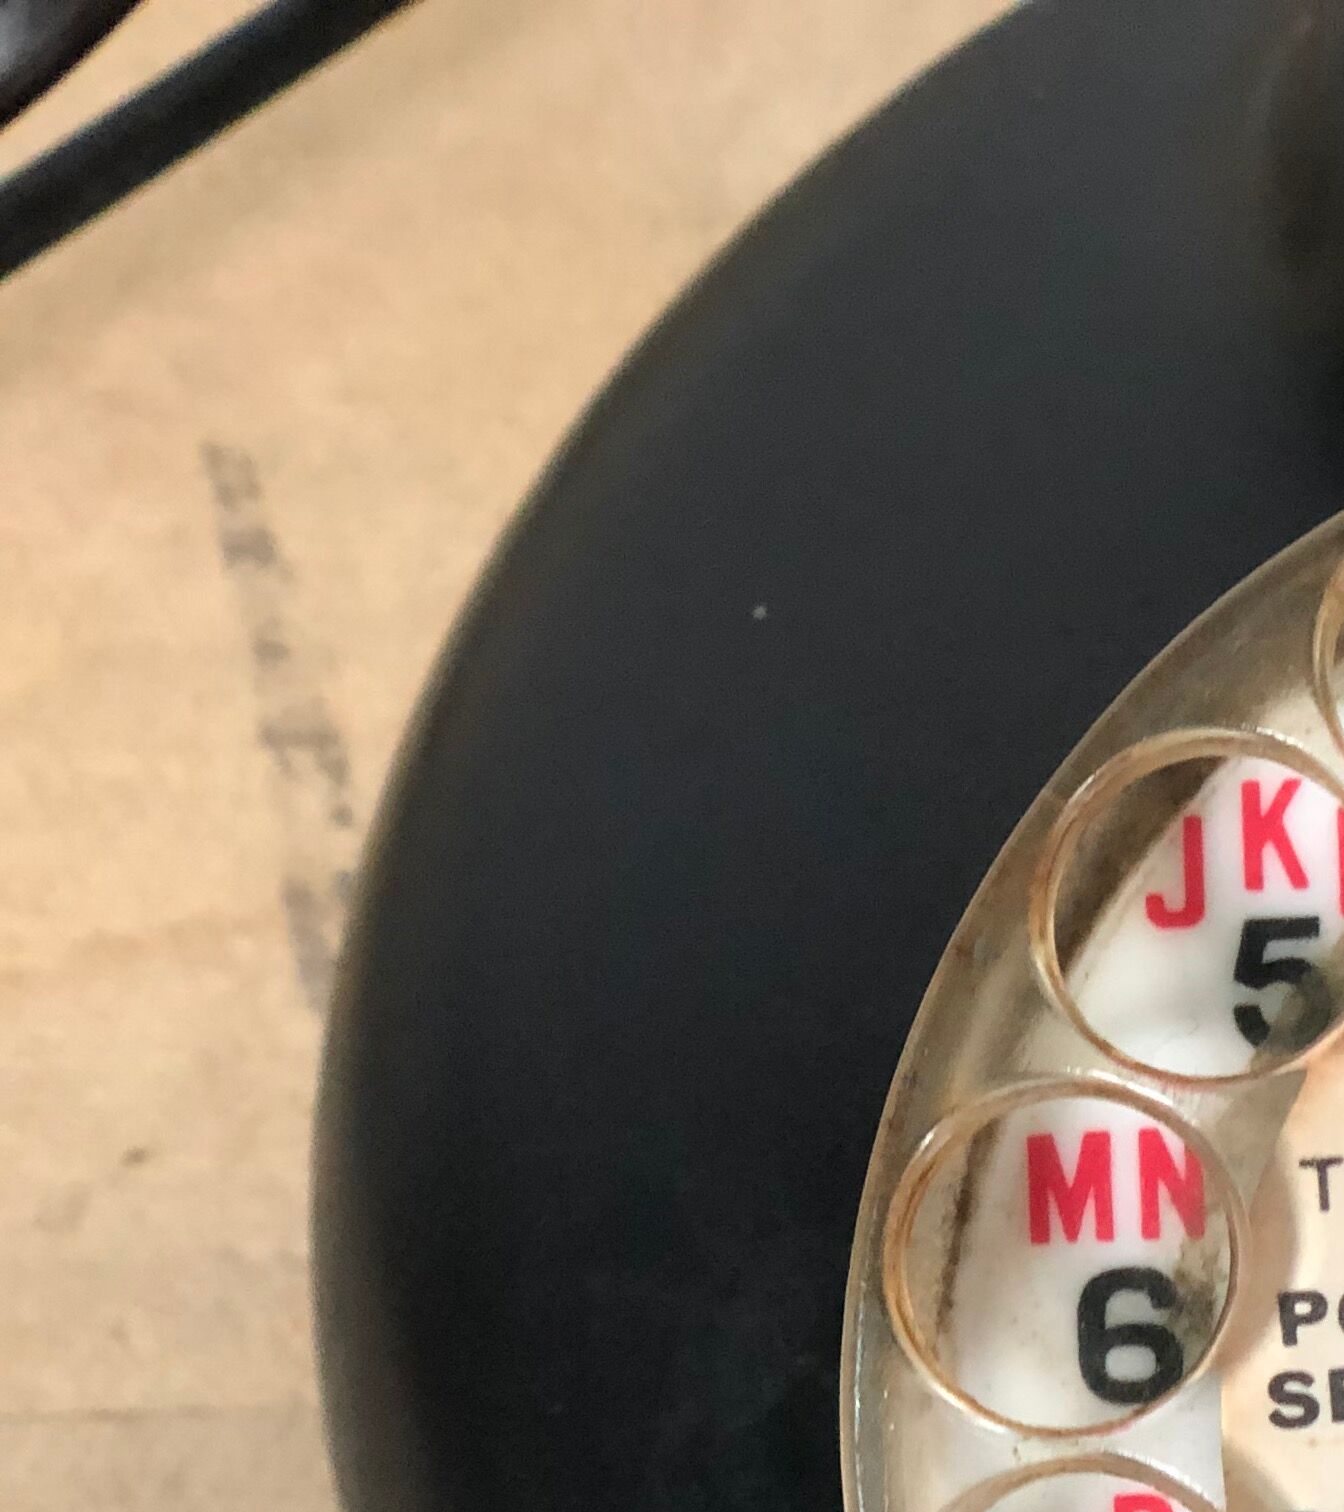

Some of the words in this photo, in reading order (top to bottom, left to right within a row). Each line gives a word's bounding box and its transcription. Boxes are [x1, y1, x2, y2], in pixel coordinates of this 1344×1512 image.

[1233, 916, 1336, 1050] 5
[1025, 1126, 1208, 1247] MN
[1077, 1267, 1186, 1404] 6
